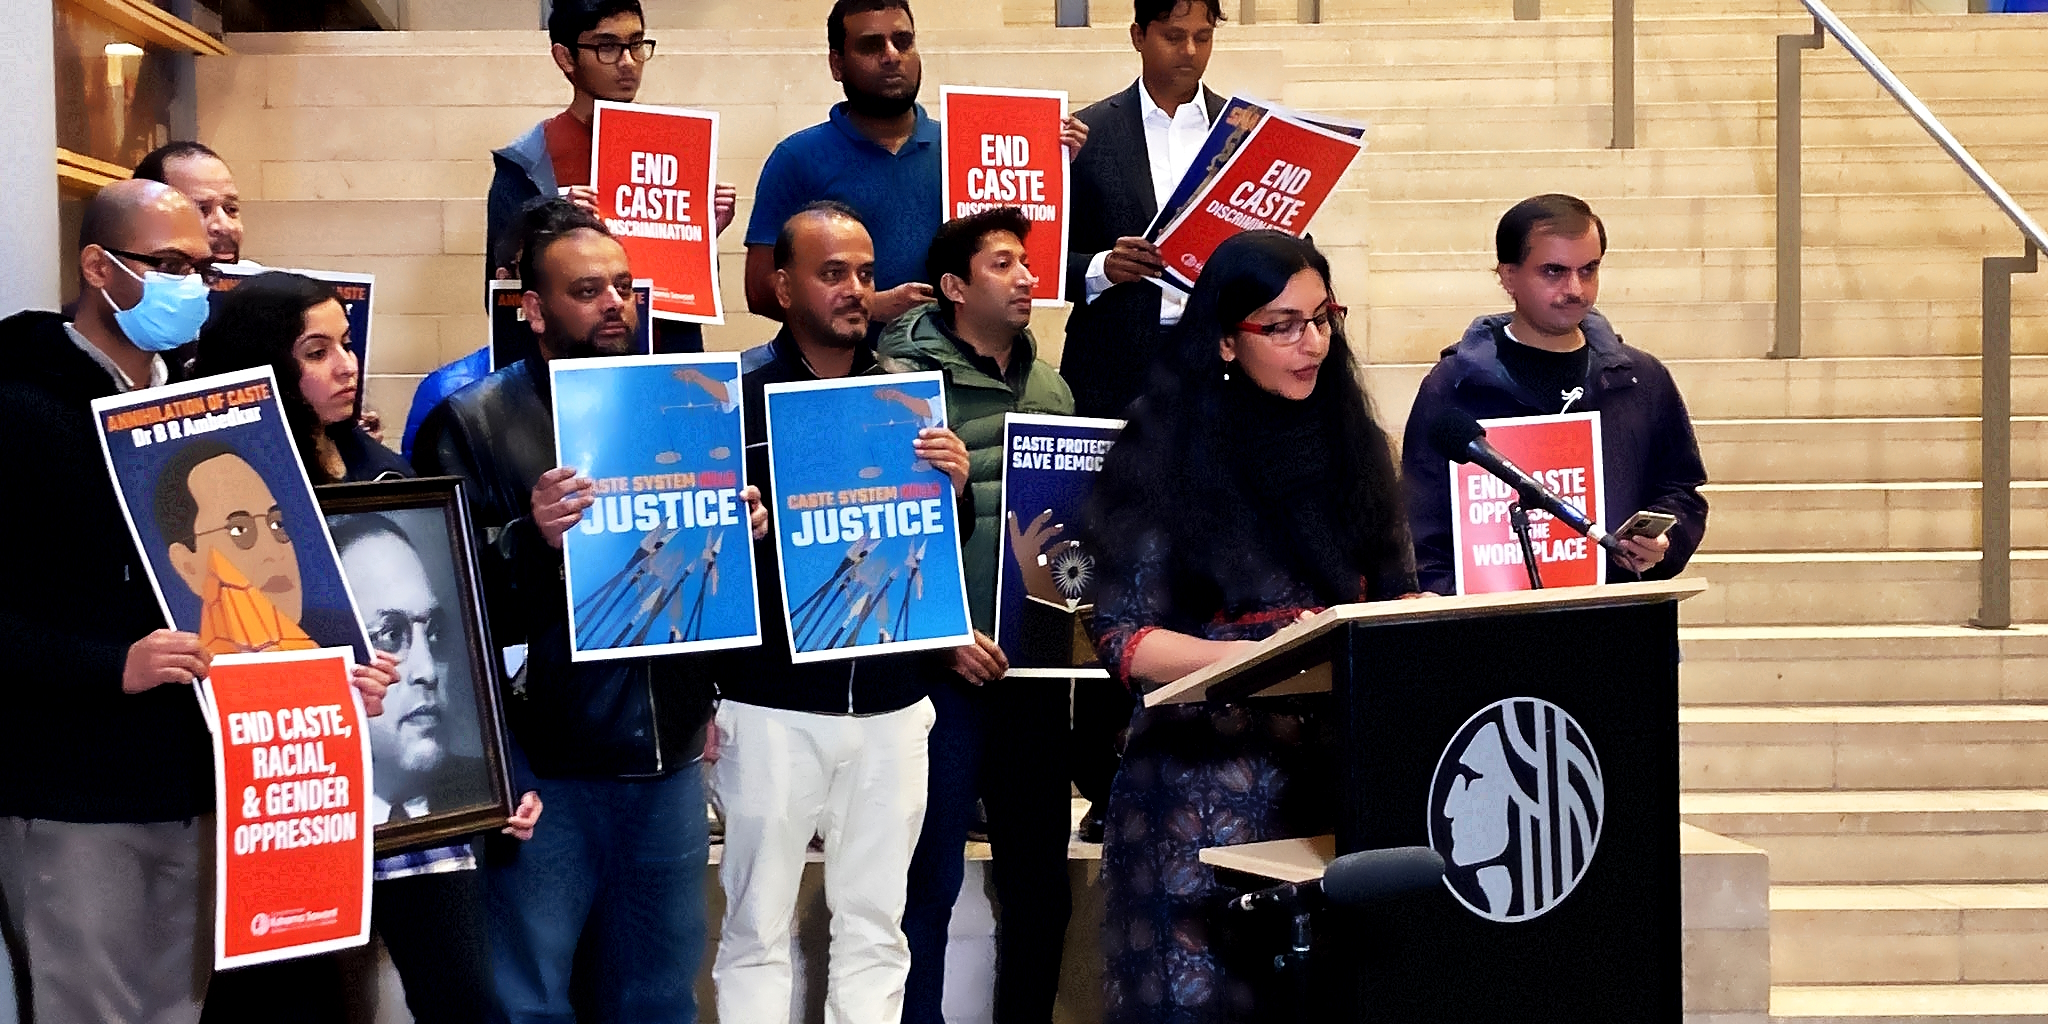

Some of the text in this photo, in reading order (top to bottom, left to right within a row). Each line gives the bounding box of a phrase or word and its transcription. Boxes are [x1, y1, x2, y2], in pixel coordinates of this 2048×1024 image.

[630, 151, 679, 187] END
[981, 134, 1030, 168] END
[967, 167, 1045, 202] CASTE
[1259, 159, 1312, 195] END
[615, 184, 690, 222] CASTE
[1229, 180, 1305, 227] CASTE
[206, 392, 225, 411] OF
[226, 383, 271, 406] CASTE
[131, 406, 262, 447] Dr B R Ambedkar
[1012, 451, 1052, 470] SAVE
[1013, 435, 1115, 455] CASTE PROTECT
[632, 472, 696, 492] SYSTEM
[838, 486, 898, 505] SYSTEM
[1467, 467, 1586, 500] END ASTE
[580, 488, 739, 536] JUSTICE
[791, 498, 944, 547] JUSTICE
[227, 704, 353, 745] END CASTE,
[252, 741, 337, 780] RACIAL,
[242, 776, 349, 819] & GENDER
[234, 811, 357, 856] OPPRESSION
